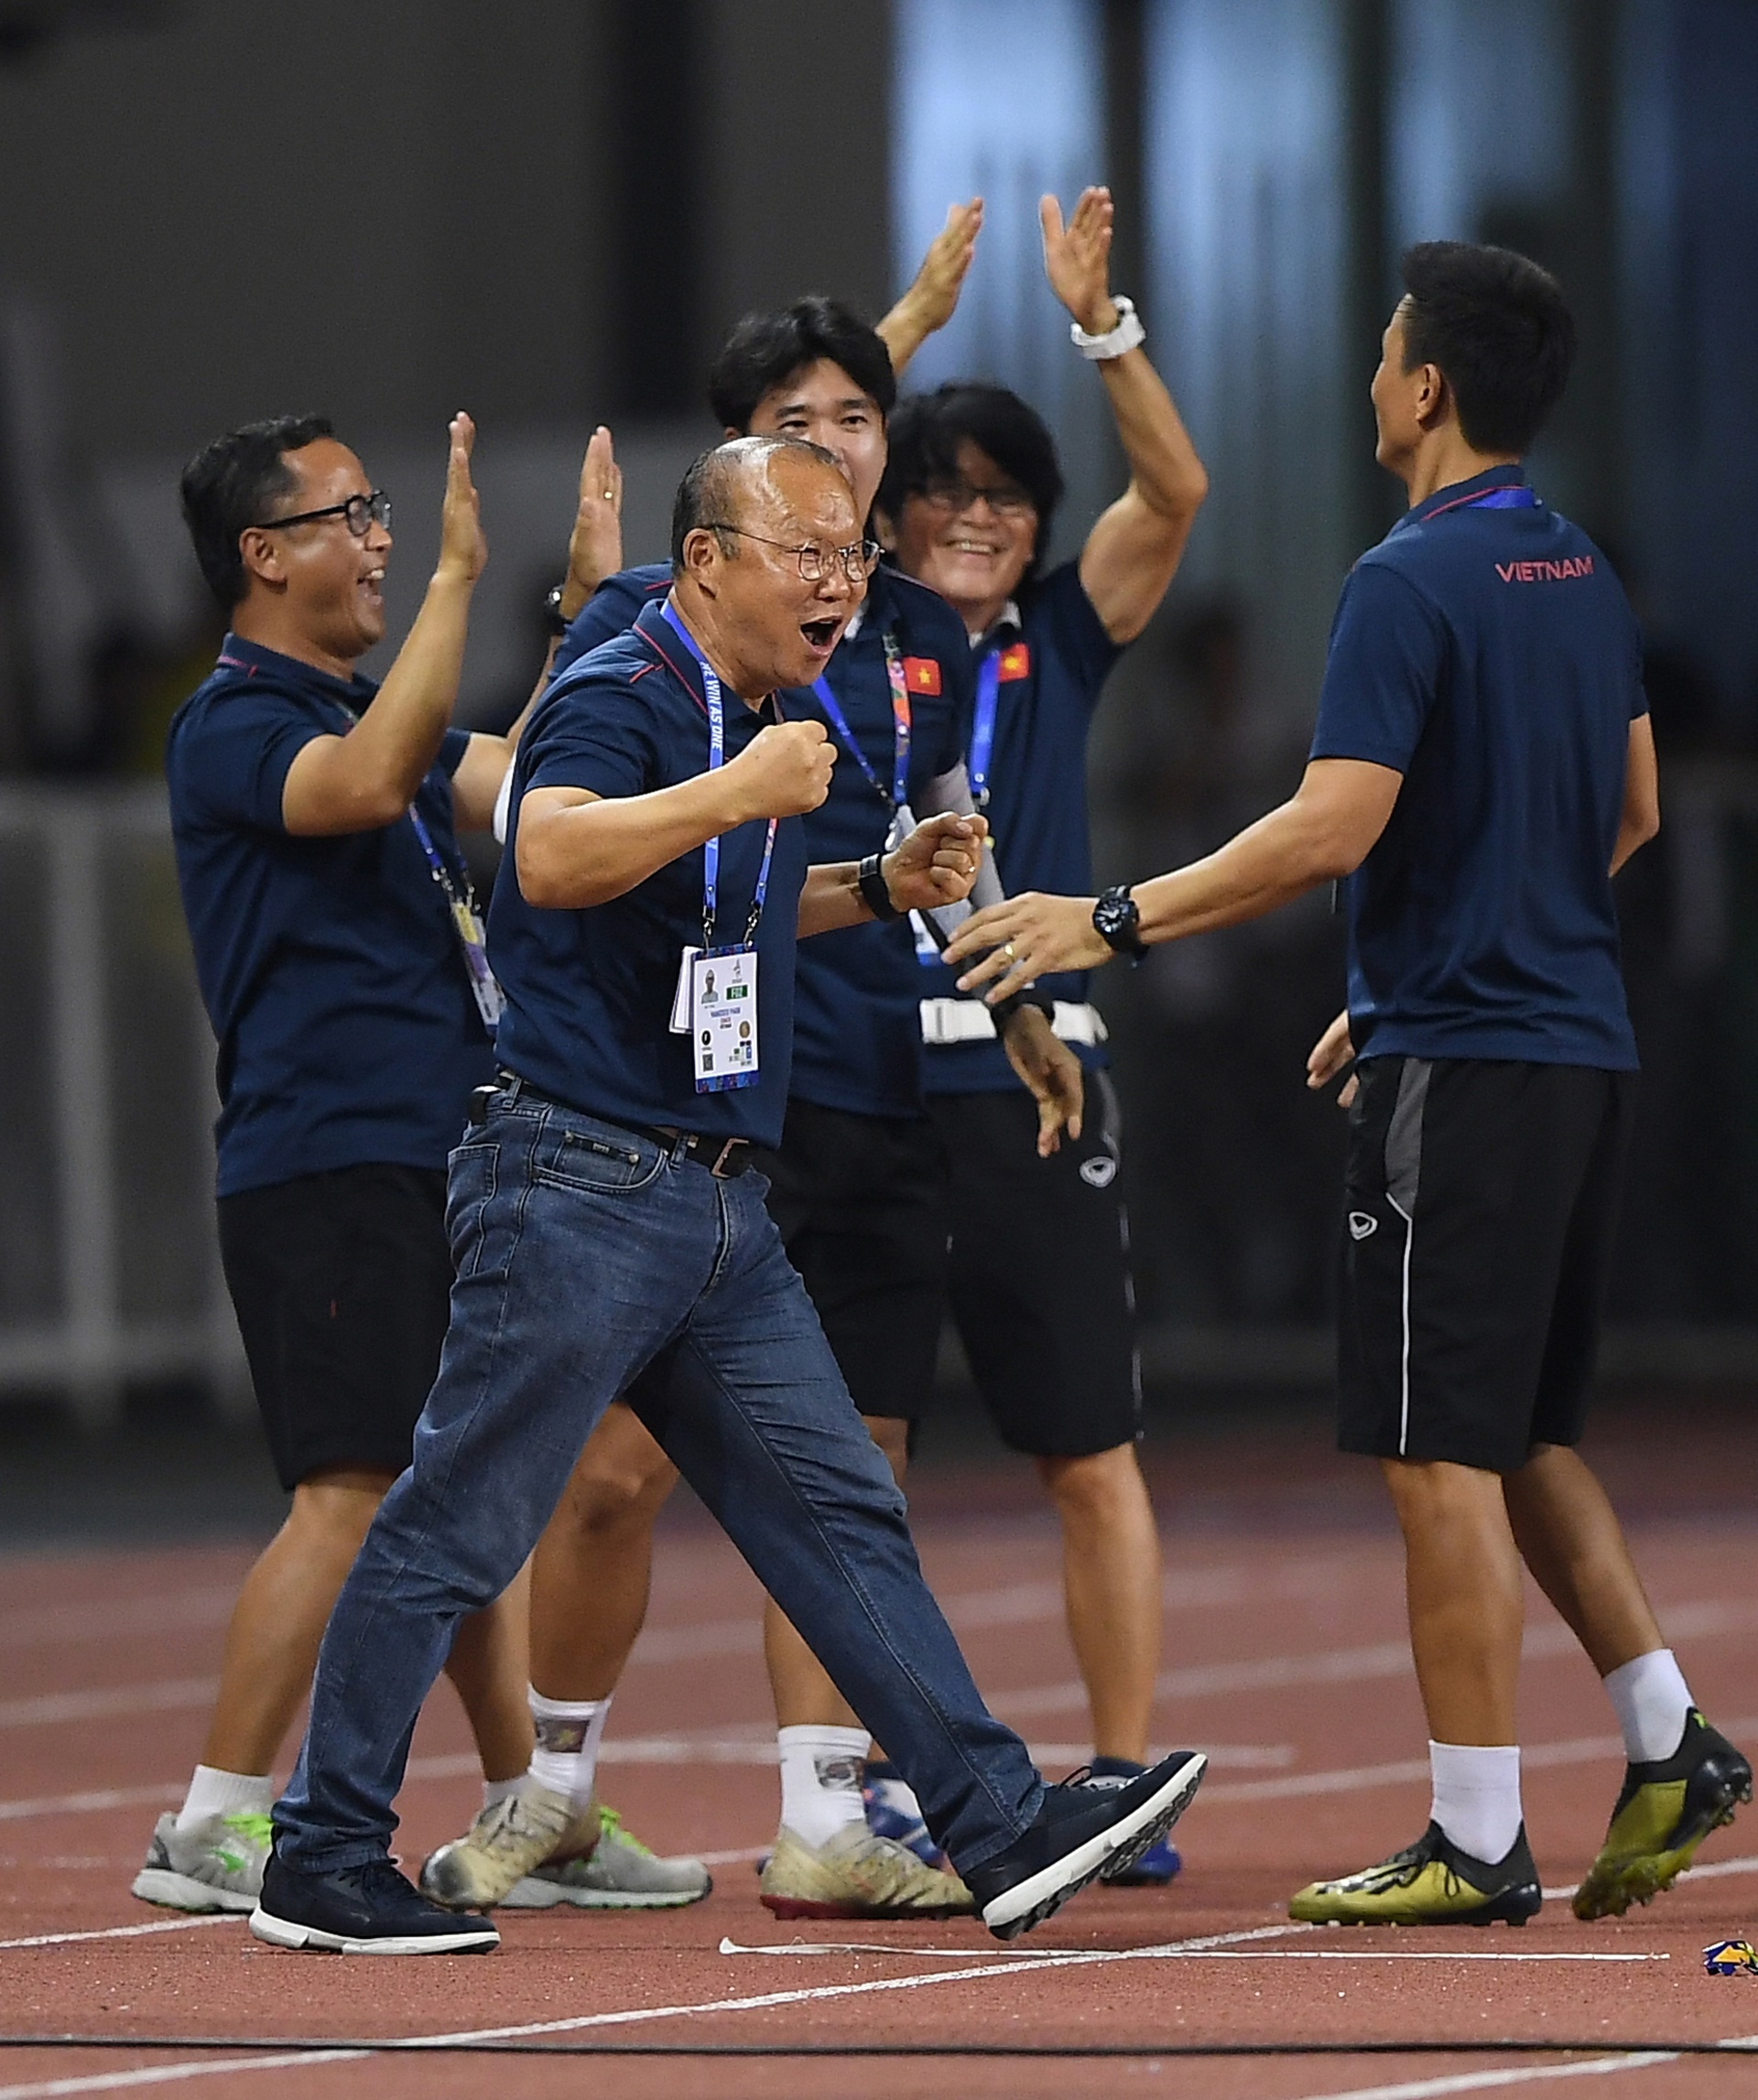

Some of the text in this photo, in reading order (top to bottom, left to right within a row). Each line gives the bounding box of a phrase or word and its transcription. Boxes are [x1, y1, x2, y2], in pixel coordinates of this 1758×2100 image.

[1494, 556, 1593, 583] VIETNAM
[706, 679, 722, 705] WIN
[710, 705, 722, 724] AS
[711, 725, 723, 753] ONE
